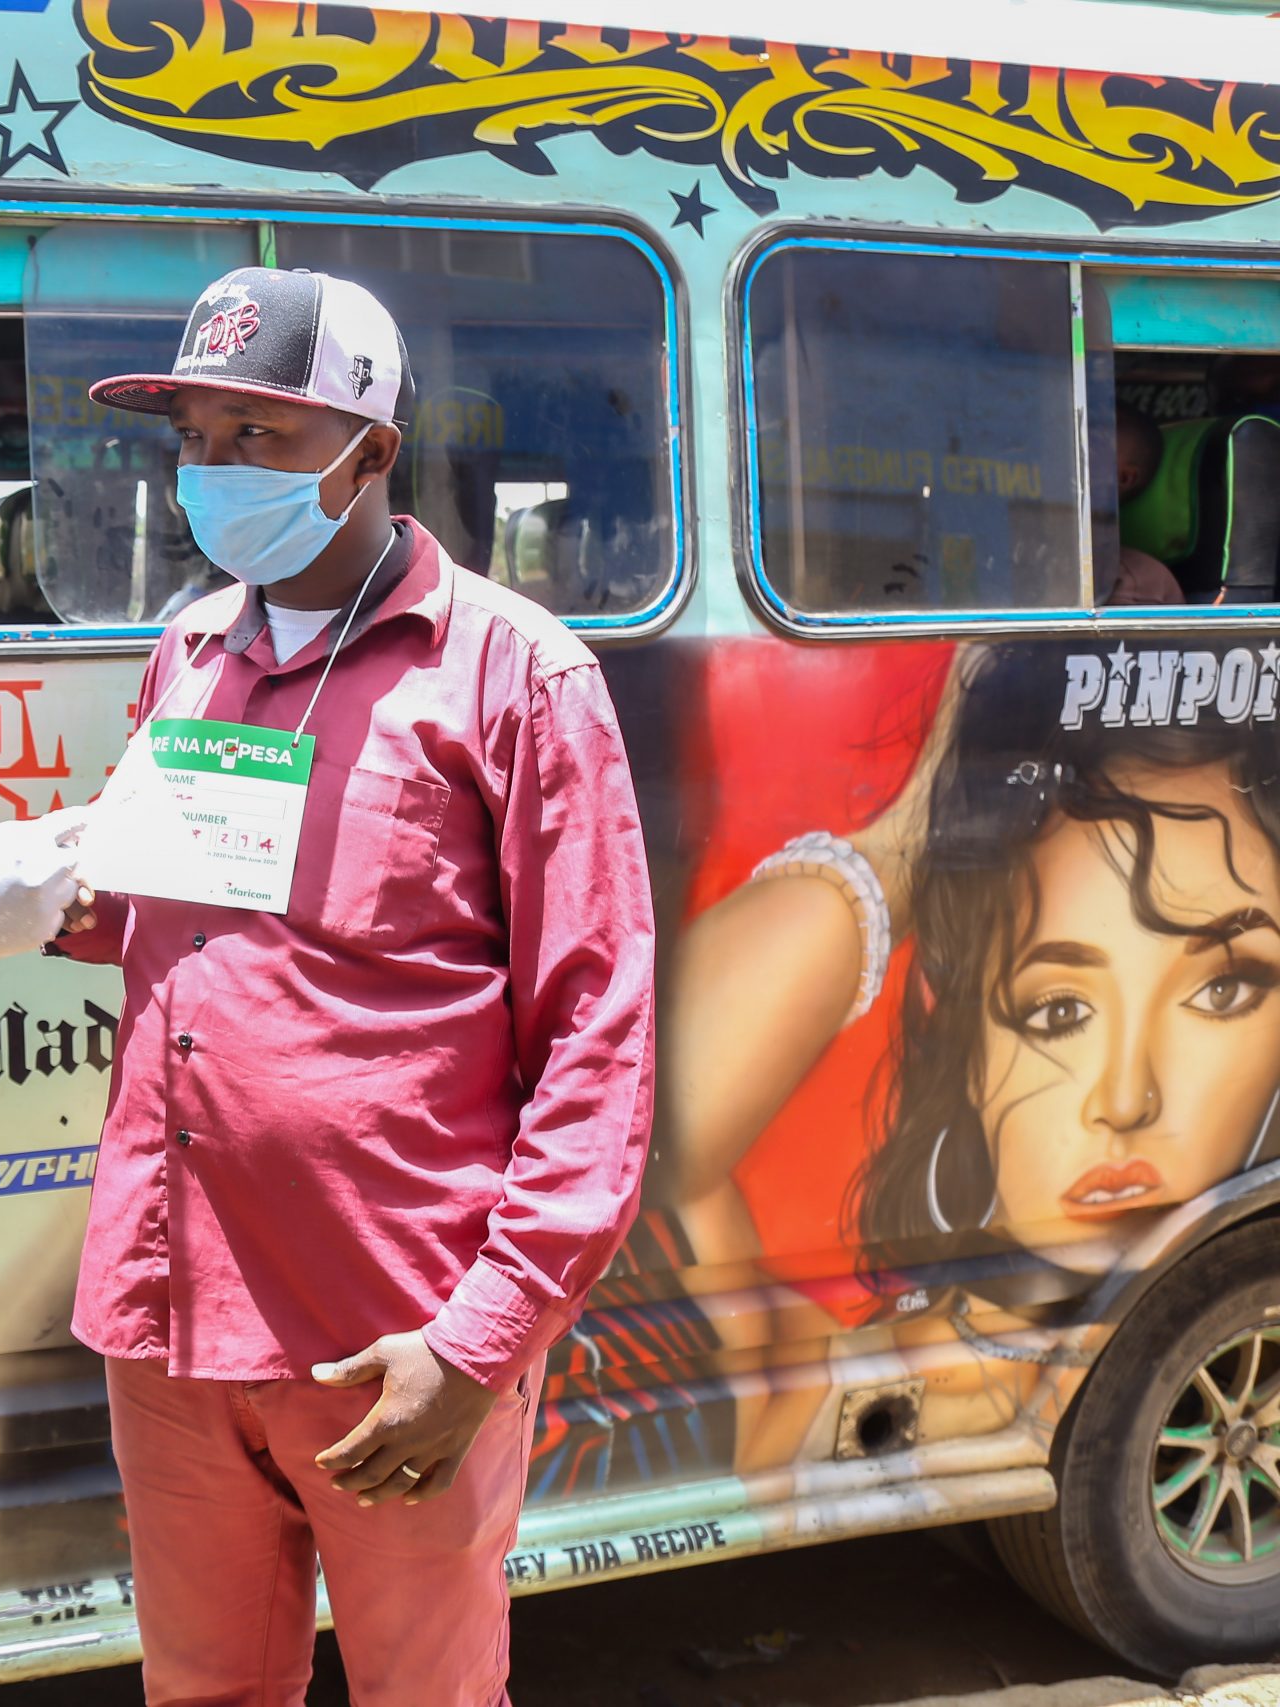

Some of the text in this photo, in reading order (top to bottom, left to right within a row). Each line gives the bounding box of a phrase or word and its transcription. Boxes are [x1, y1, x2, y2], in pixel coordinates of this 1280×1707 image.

[174, 737, 200, 755] NA
[164, 773, 196, 785] NAME
[182, 812, 228, 826] NUMBER
[224, 885, 272, 900] afaricom
[563, 1541, 621, 1577] THA
[631, 1521, 727, 1564] RECIPE
